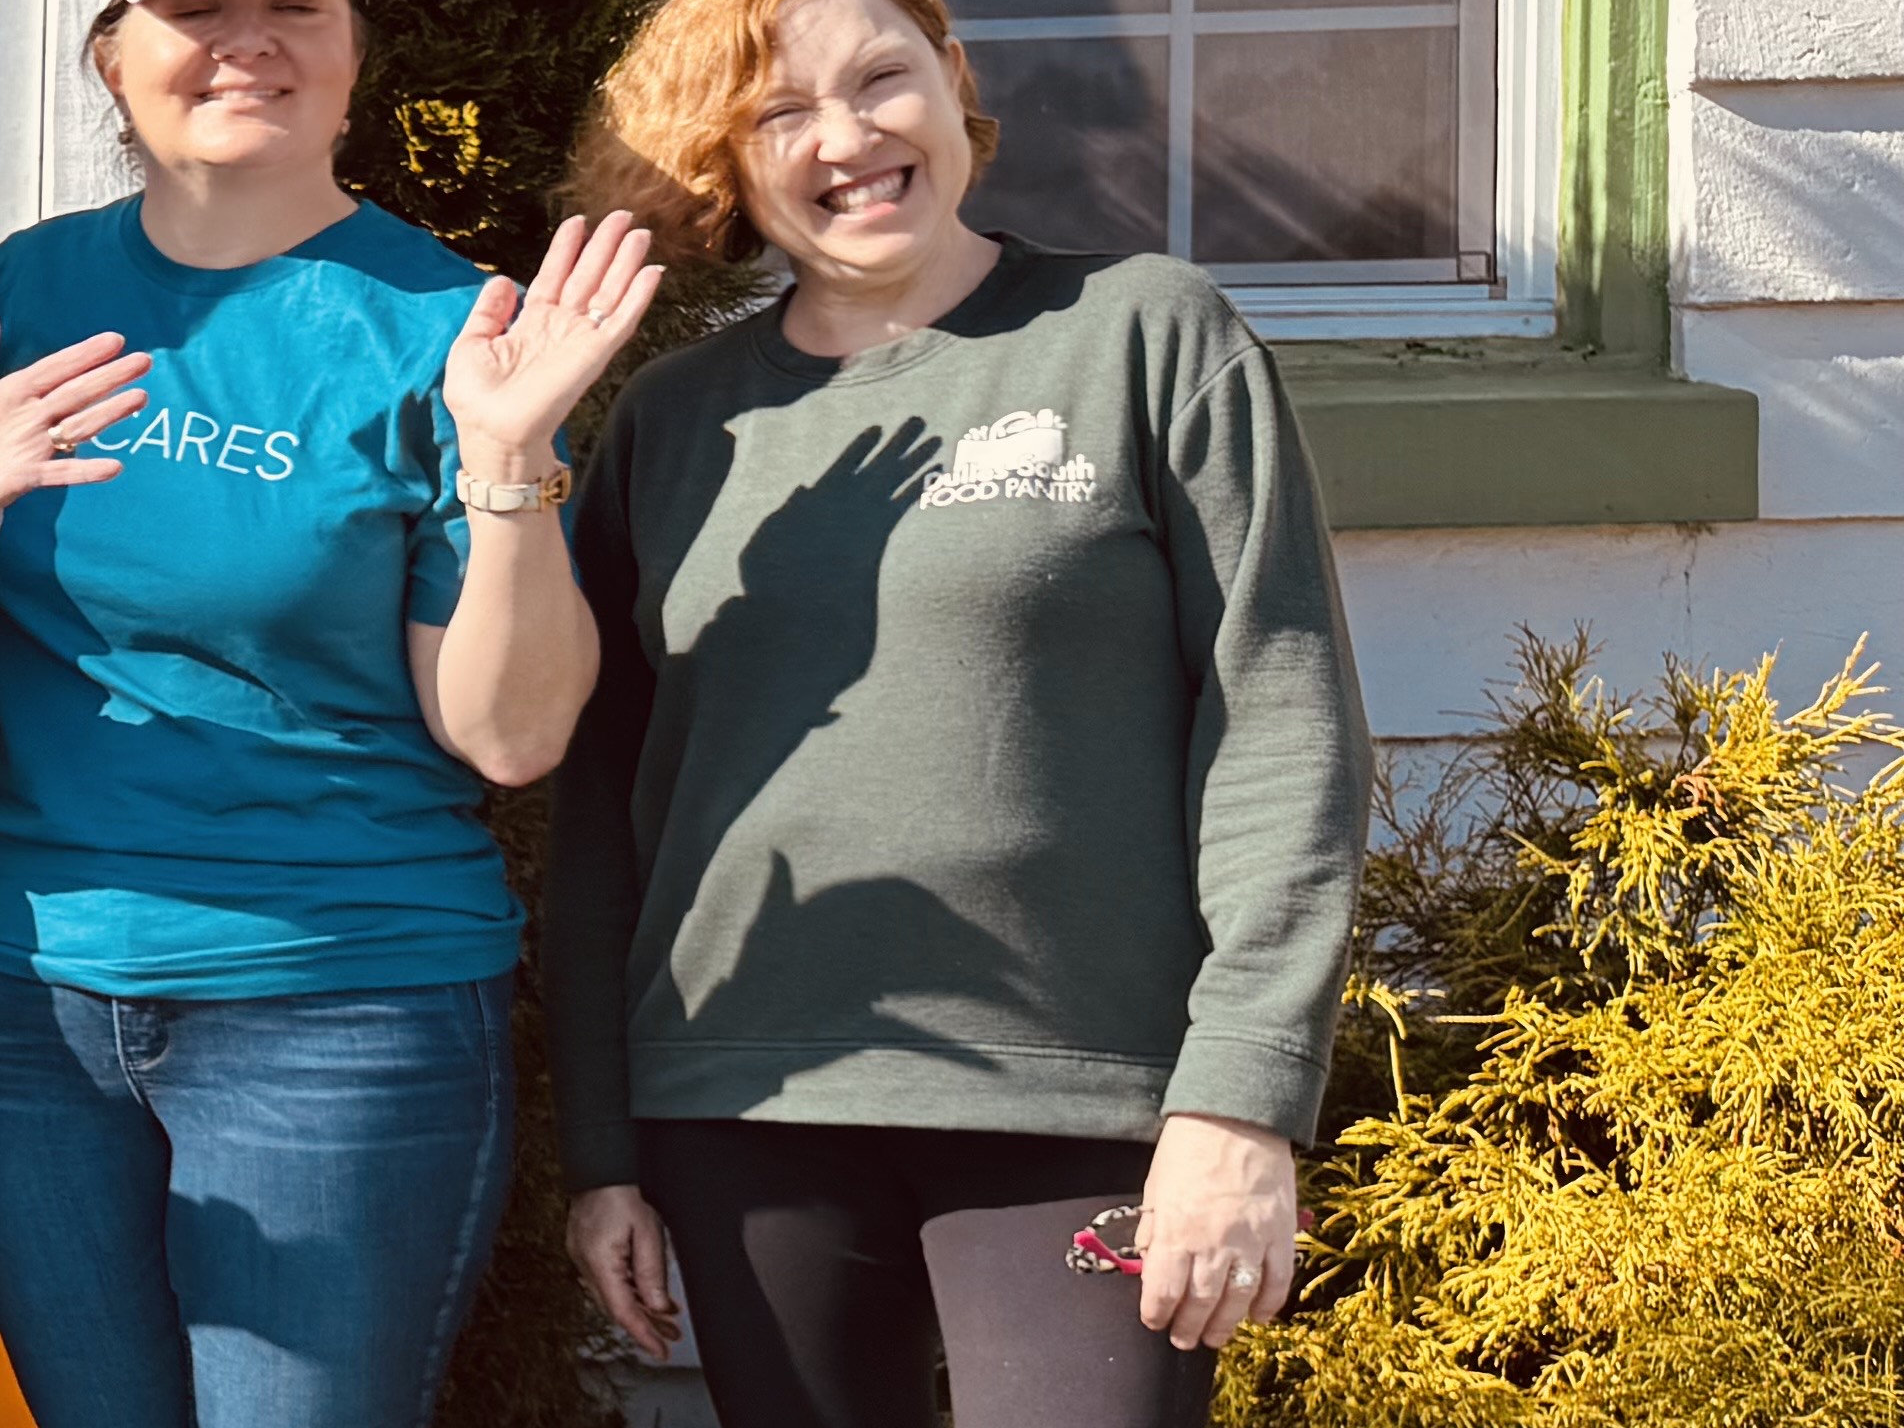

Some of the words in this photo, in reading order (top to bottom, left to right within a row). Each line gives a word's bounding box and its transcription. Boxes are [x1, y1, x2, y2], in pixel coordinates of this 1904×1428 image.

[1017, 454, 1096, 482] South
[920, 482, 999, 510] FOOD
[1005, 477, 1096, 502] PANTRY
